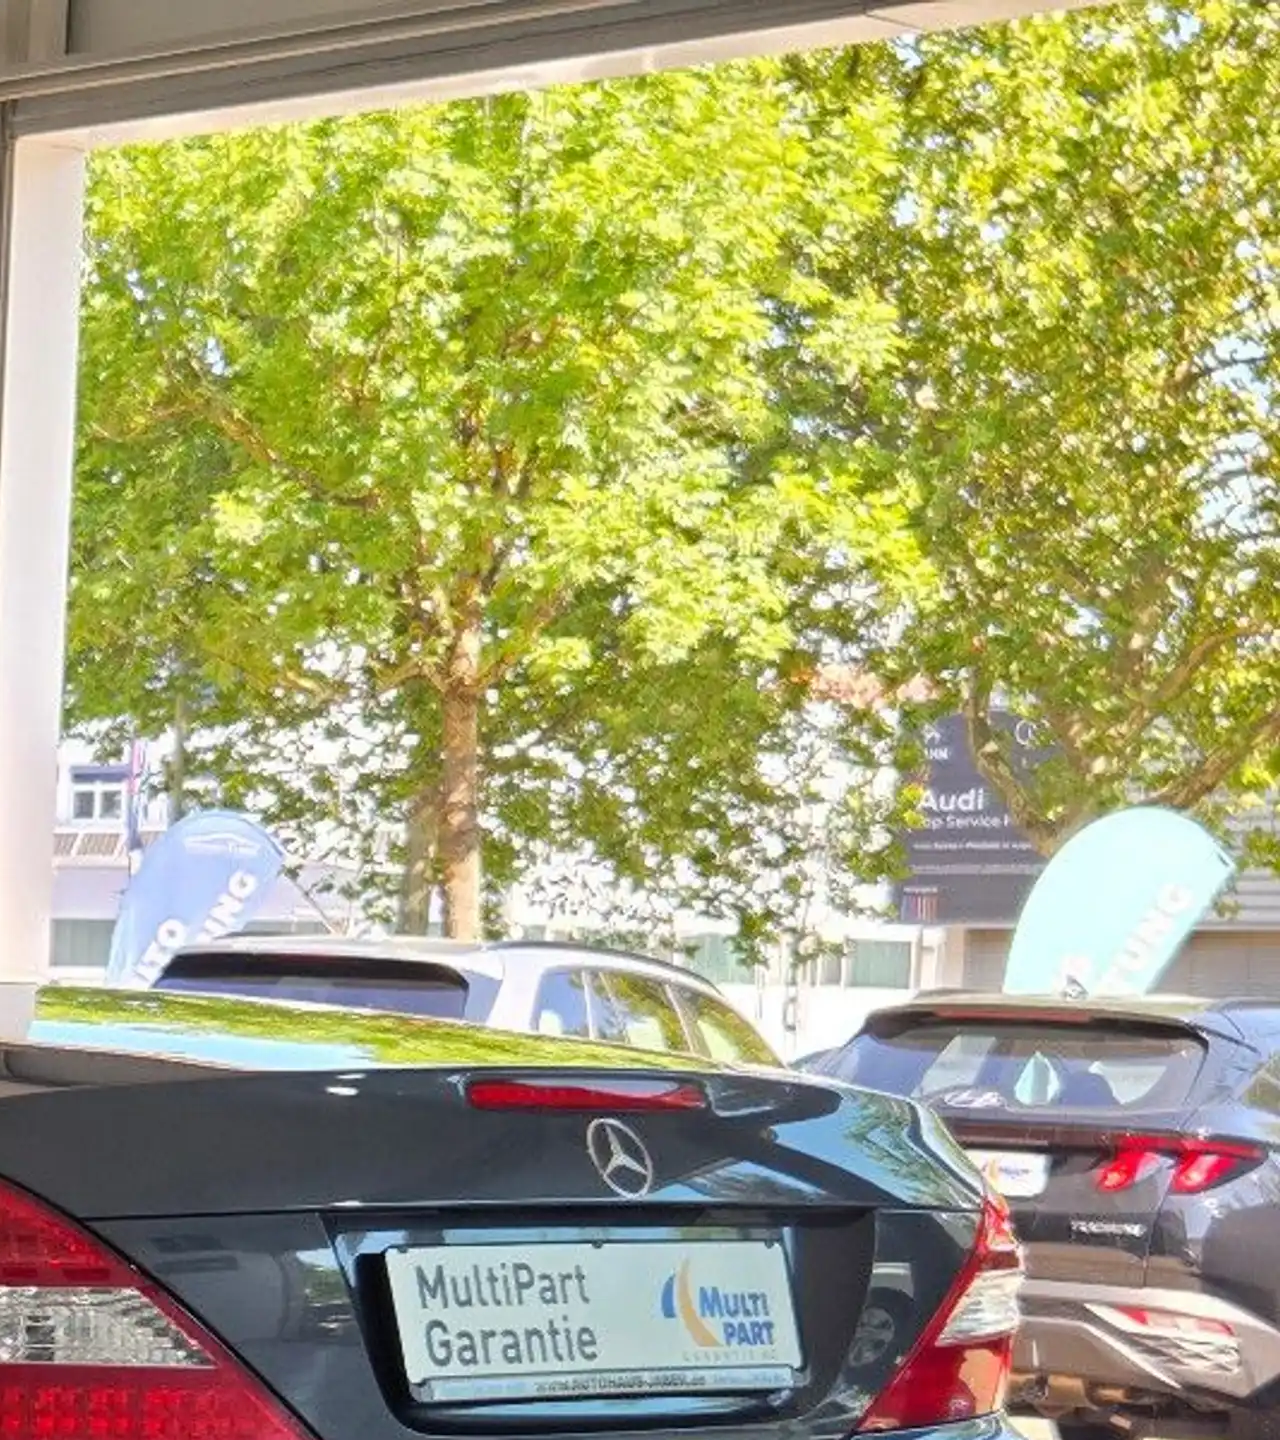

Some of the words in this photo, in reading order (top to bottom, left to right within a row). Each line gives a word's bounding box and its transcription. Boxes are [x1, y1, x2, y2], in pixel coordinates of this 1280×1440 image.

[917, 787, 985, 812] Audi
[946, 815, 1004, 829] Service
[414, 1262, 591, 1310] MultiPart
[698, 1286, 771, 1319] MULTI
[425, 1315, 599, 1367] Garantie
[723, 1320, 775, 1348] PART
